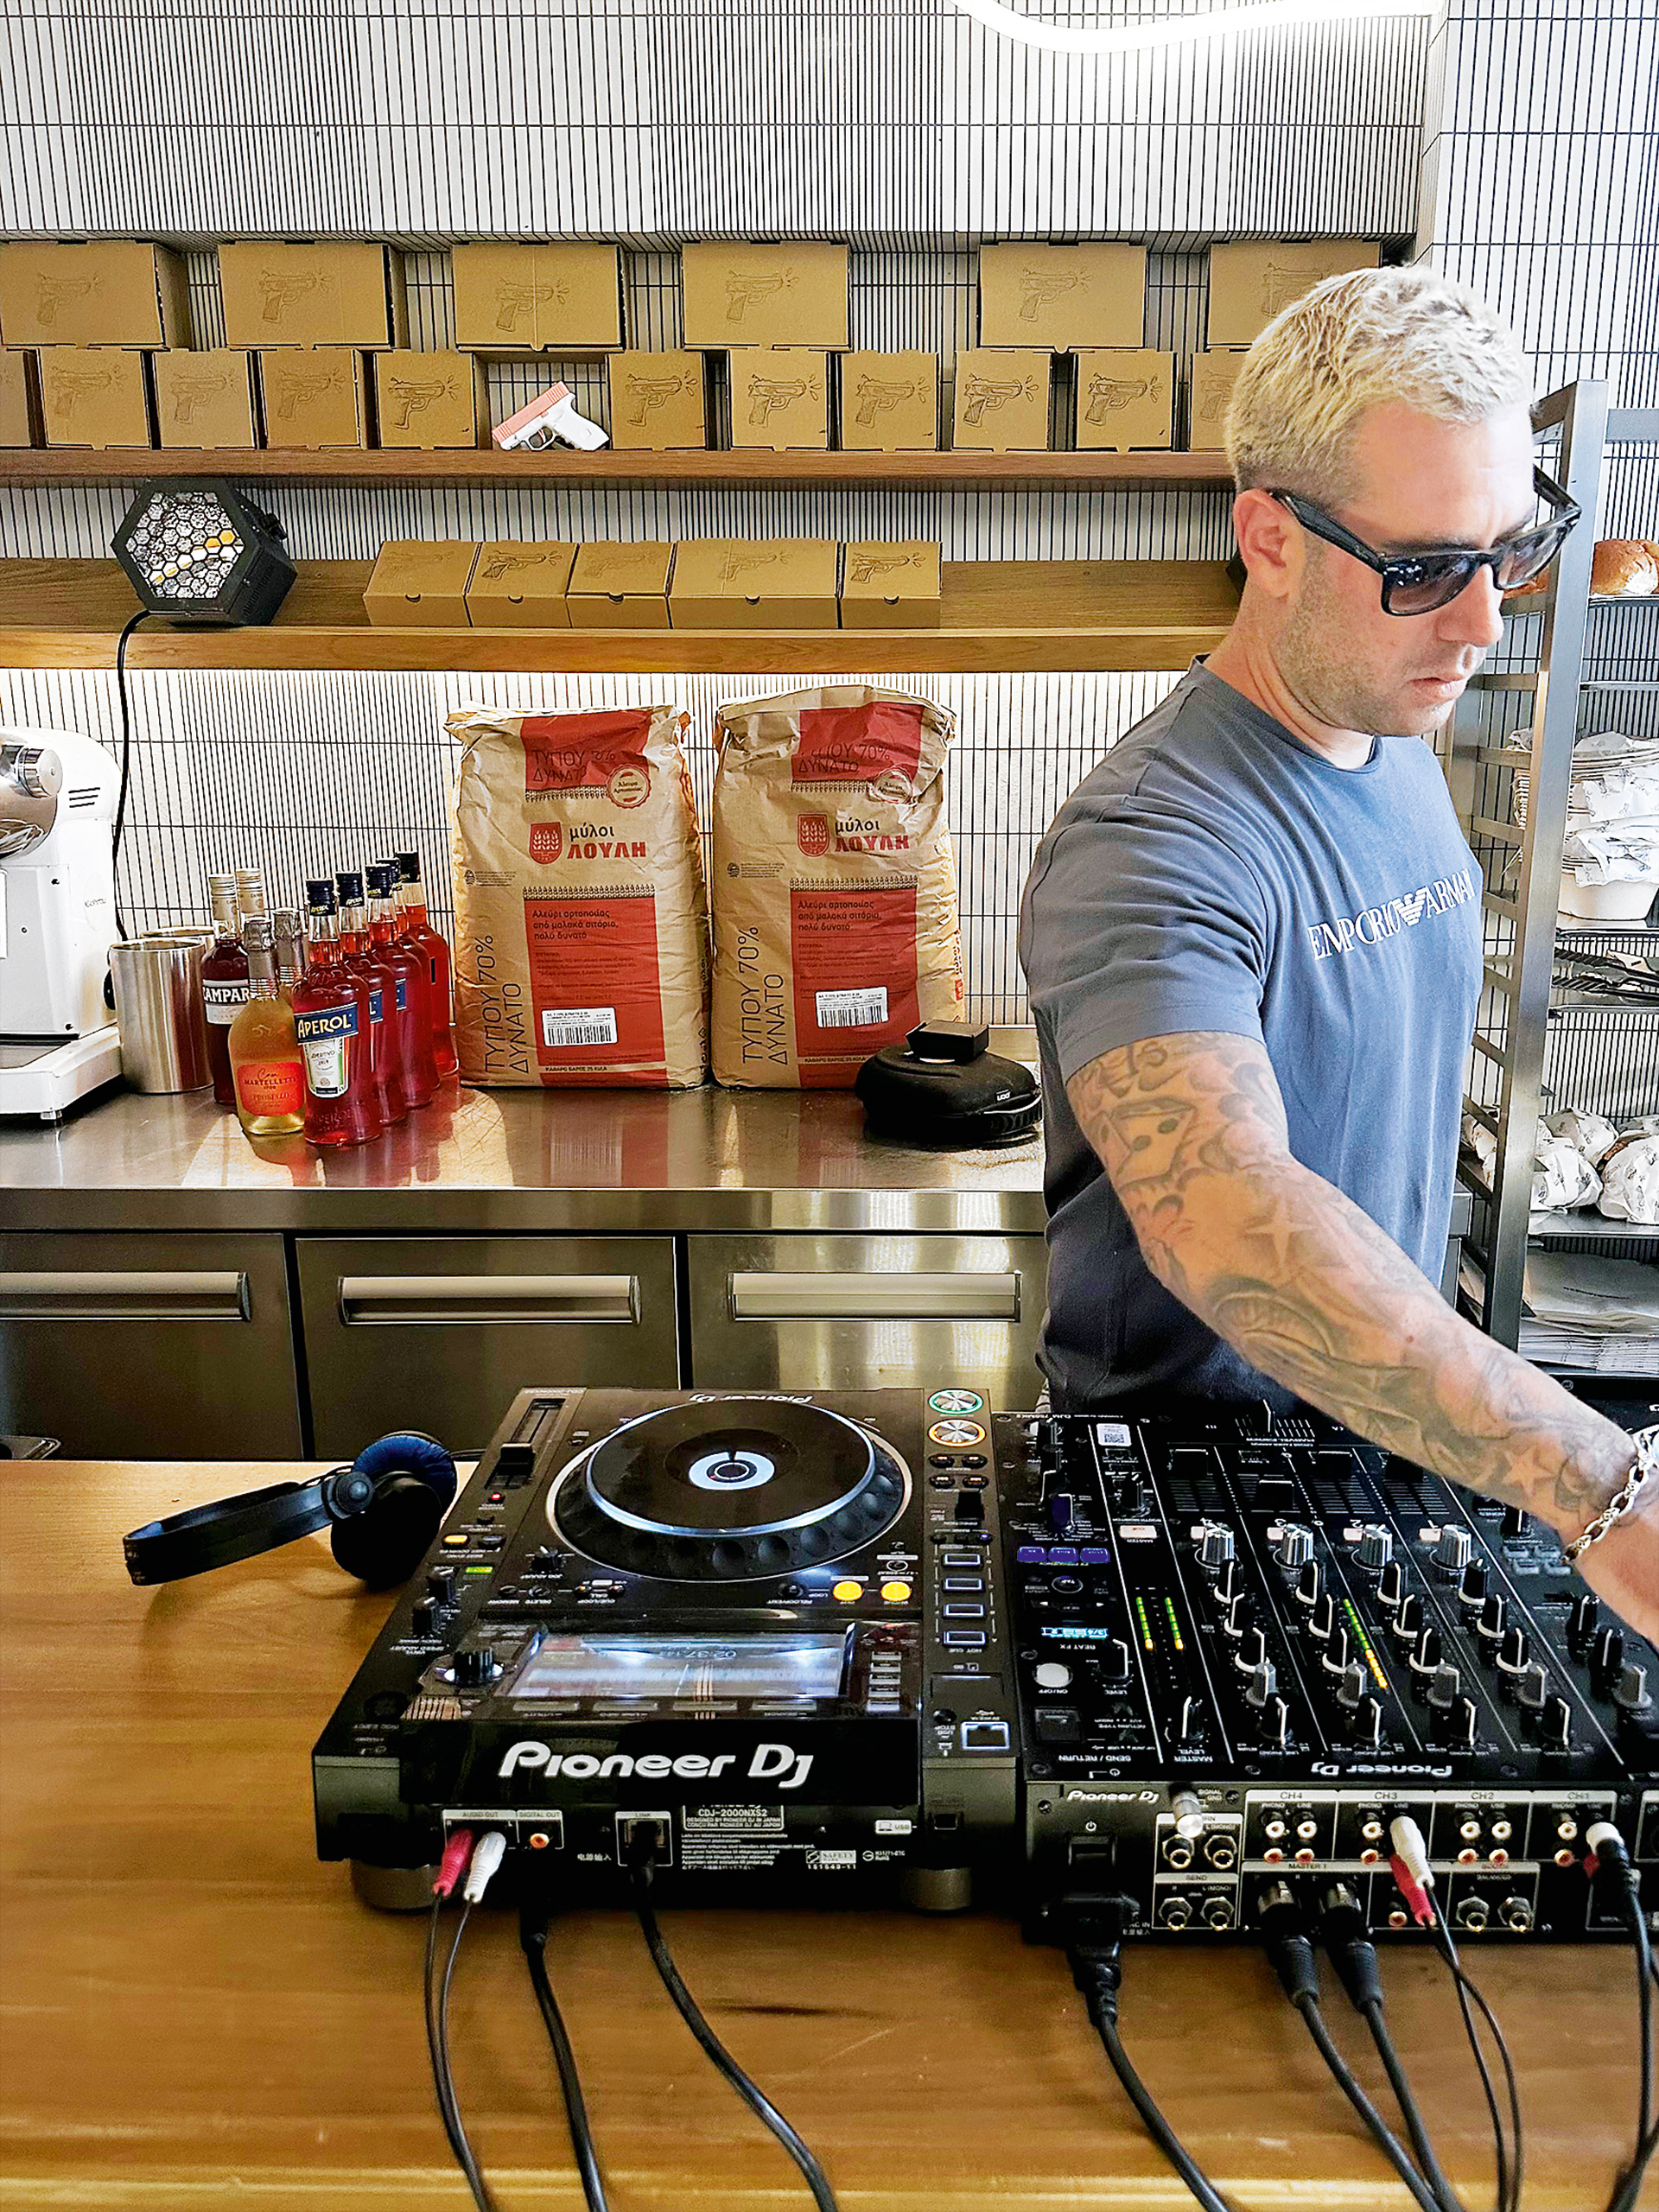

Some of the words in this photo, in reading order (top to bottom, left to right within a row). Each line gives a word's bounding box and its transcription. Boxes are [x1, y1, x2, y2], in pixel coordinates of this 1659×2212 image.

[532, 749, 586, 767] ΤΥΠΟΥ
[858, 743, 891, 761] 70%
[798, 760, 860, 774] ΔΥΝΑΤΟ
[569, 822, 615, 842] μύλοι
[834, 817, 880, 835] μύλοι
[567, 842, 646, 860] ΛΟΥΛΗ
[834, 835, 909, 853] ΛΟΥΛΗ
[532, 910, 563, 919] Αλεύρι
[534, 931, 555, 940] πολύ
[557, 931, 588, 940] δυνατό
[1307, 900, 1402, 960] EMPORIO
[475, 935, 497, 982] 70%
[737, 926, 760, 974] 70%
[297, 1014, 352, 1038] APEROL
[502, 982, 529, 1074] ΔΥΝΑΤΟ
[741, 982, 763, 1064] ΤΥΠΟΥ
[764, 974, 788, 1065] ΔΥΝΑΤΟ
[480, 990, 505, 1072] ΤΥΠΟΥ
[720, 1395, 813, 1403] Pioneer
[498, 1741, 736, 1778] Pioneer
[1346, 1765, 1452, 1777] Pioneer
[1067, 1790, 1136, 1802] Pioneer
[698, 1808, 767, 1817] CDJ-2000NXS2
